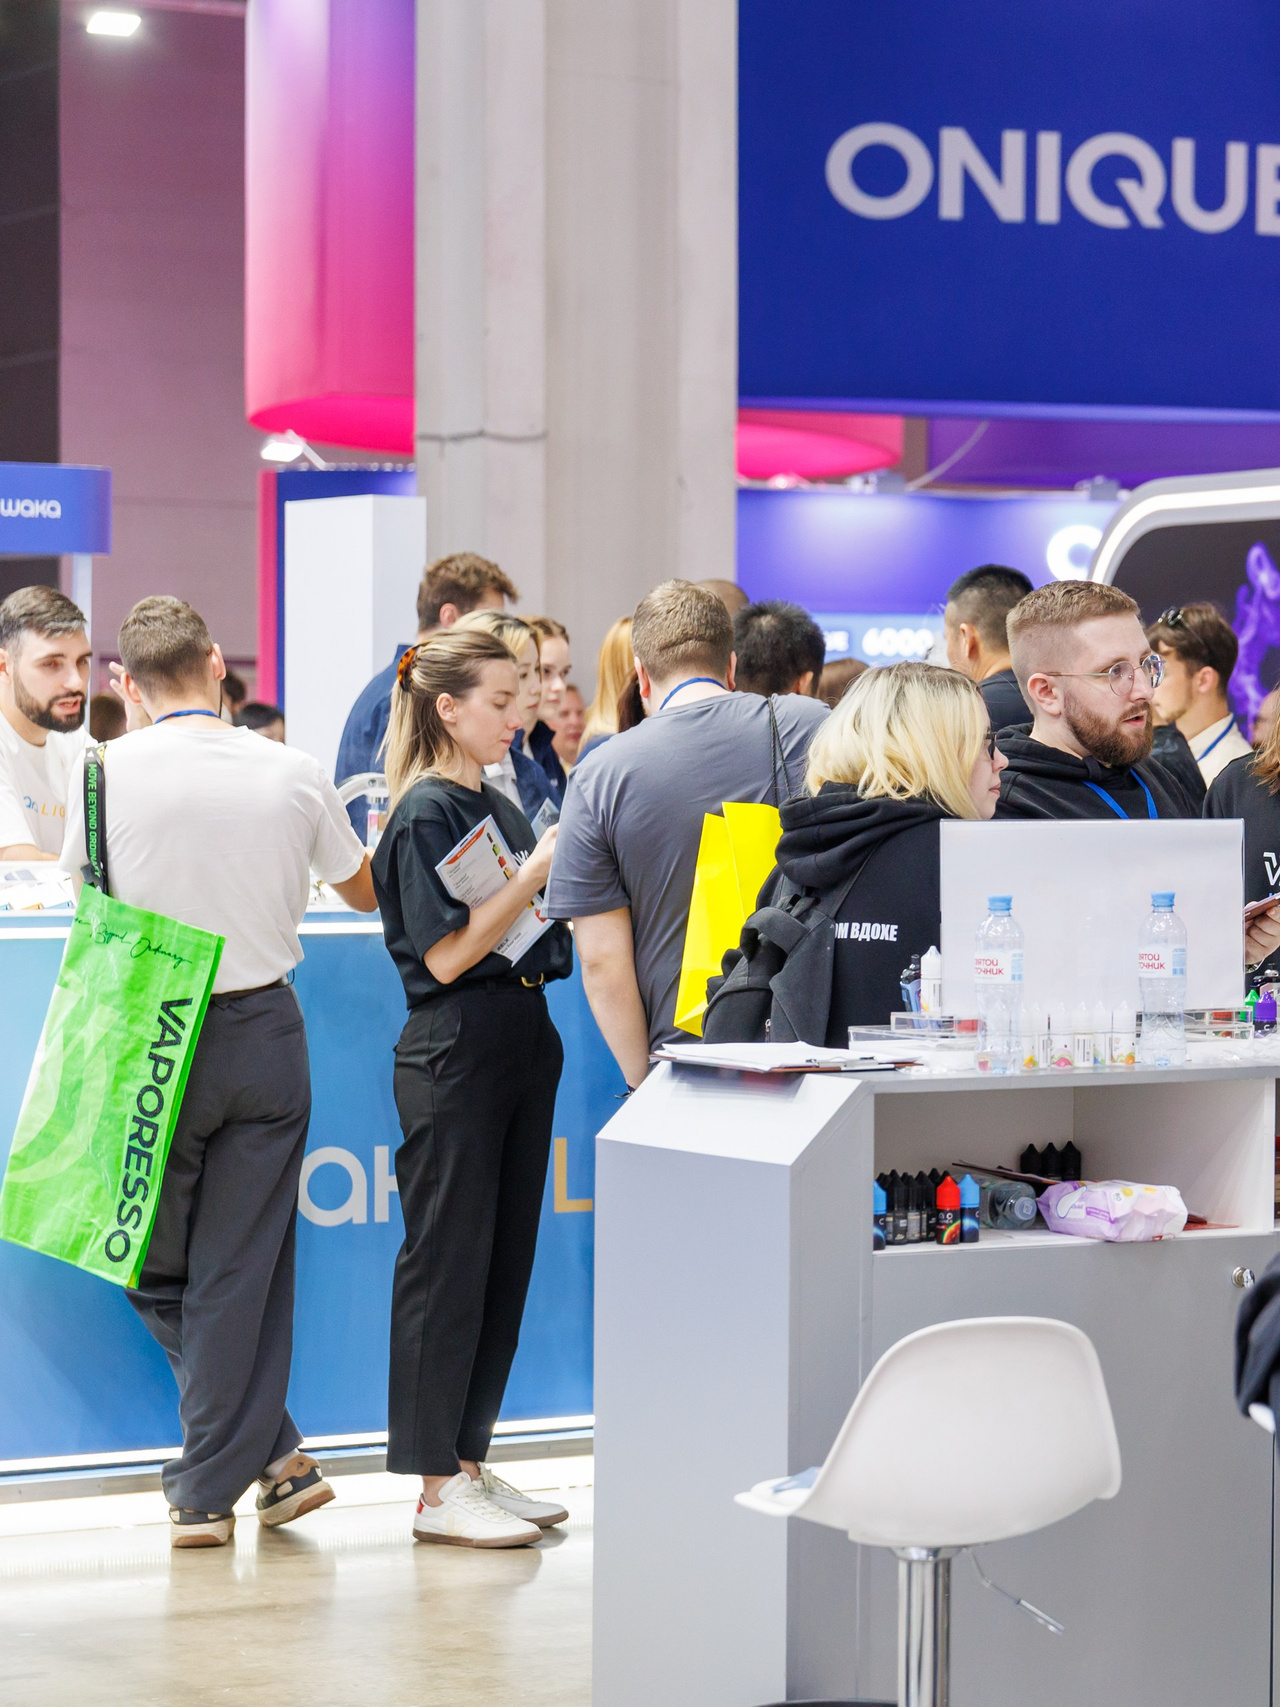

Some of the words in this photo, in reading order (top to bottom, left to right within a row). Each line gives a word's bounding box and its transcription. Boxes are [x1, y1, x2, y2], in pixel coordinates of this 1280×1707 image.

[87, 763, 98, 790] MOVE
[87, 792, 98, 829] BEYOND
[850, 922, 898, 941] ВДОХЕ
[104, 997, 194, 1262] VAPORESSO
